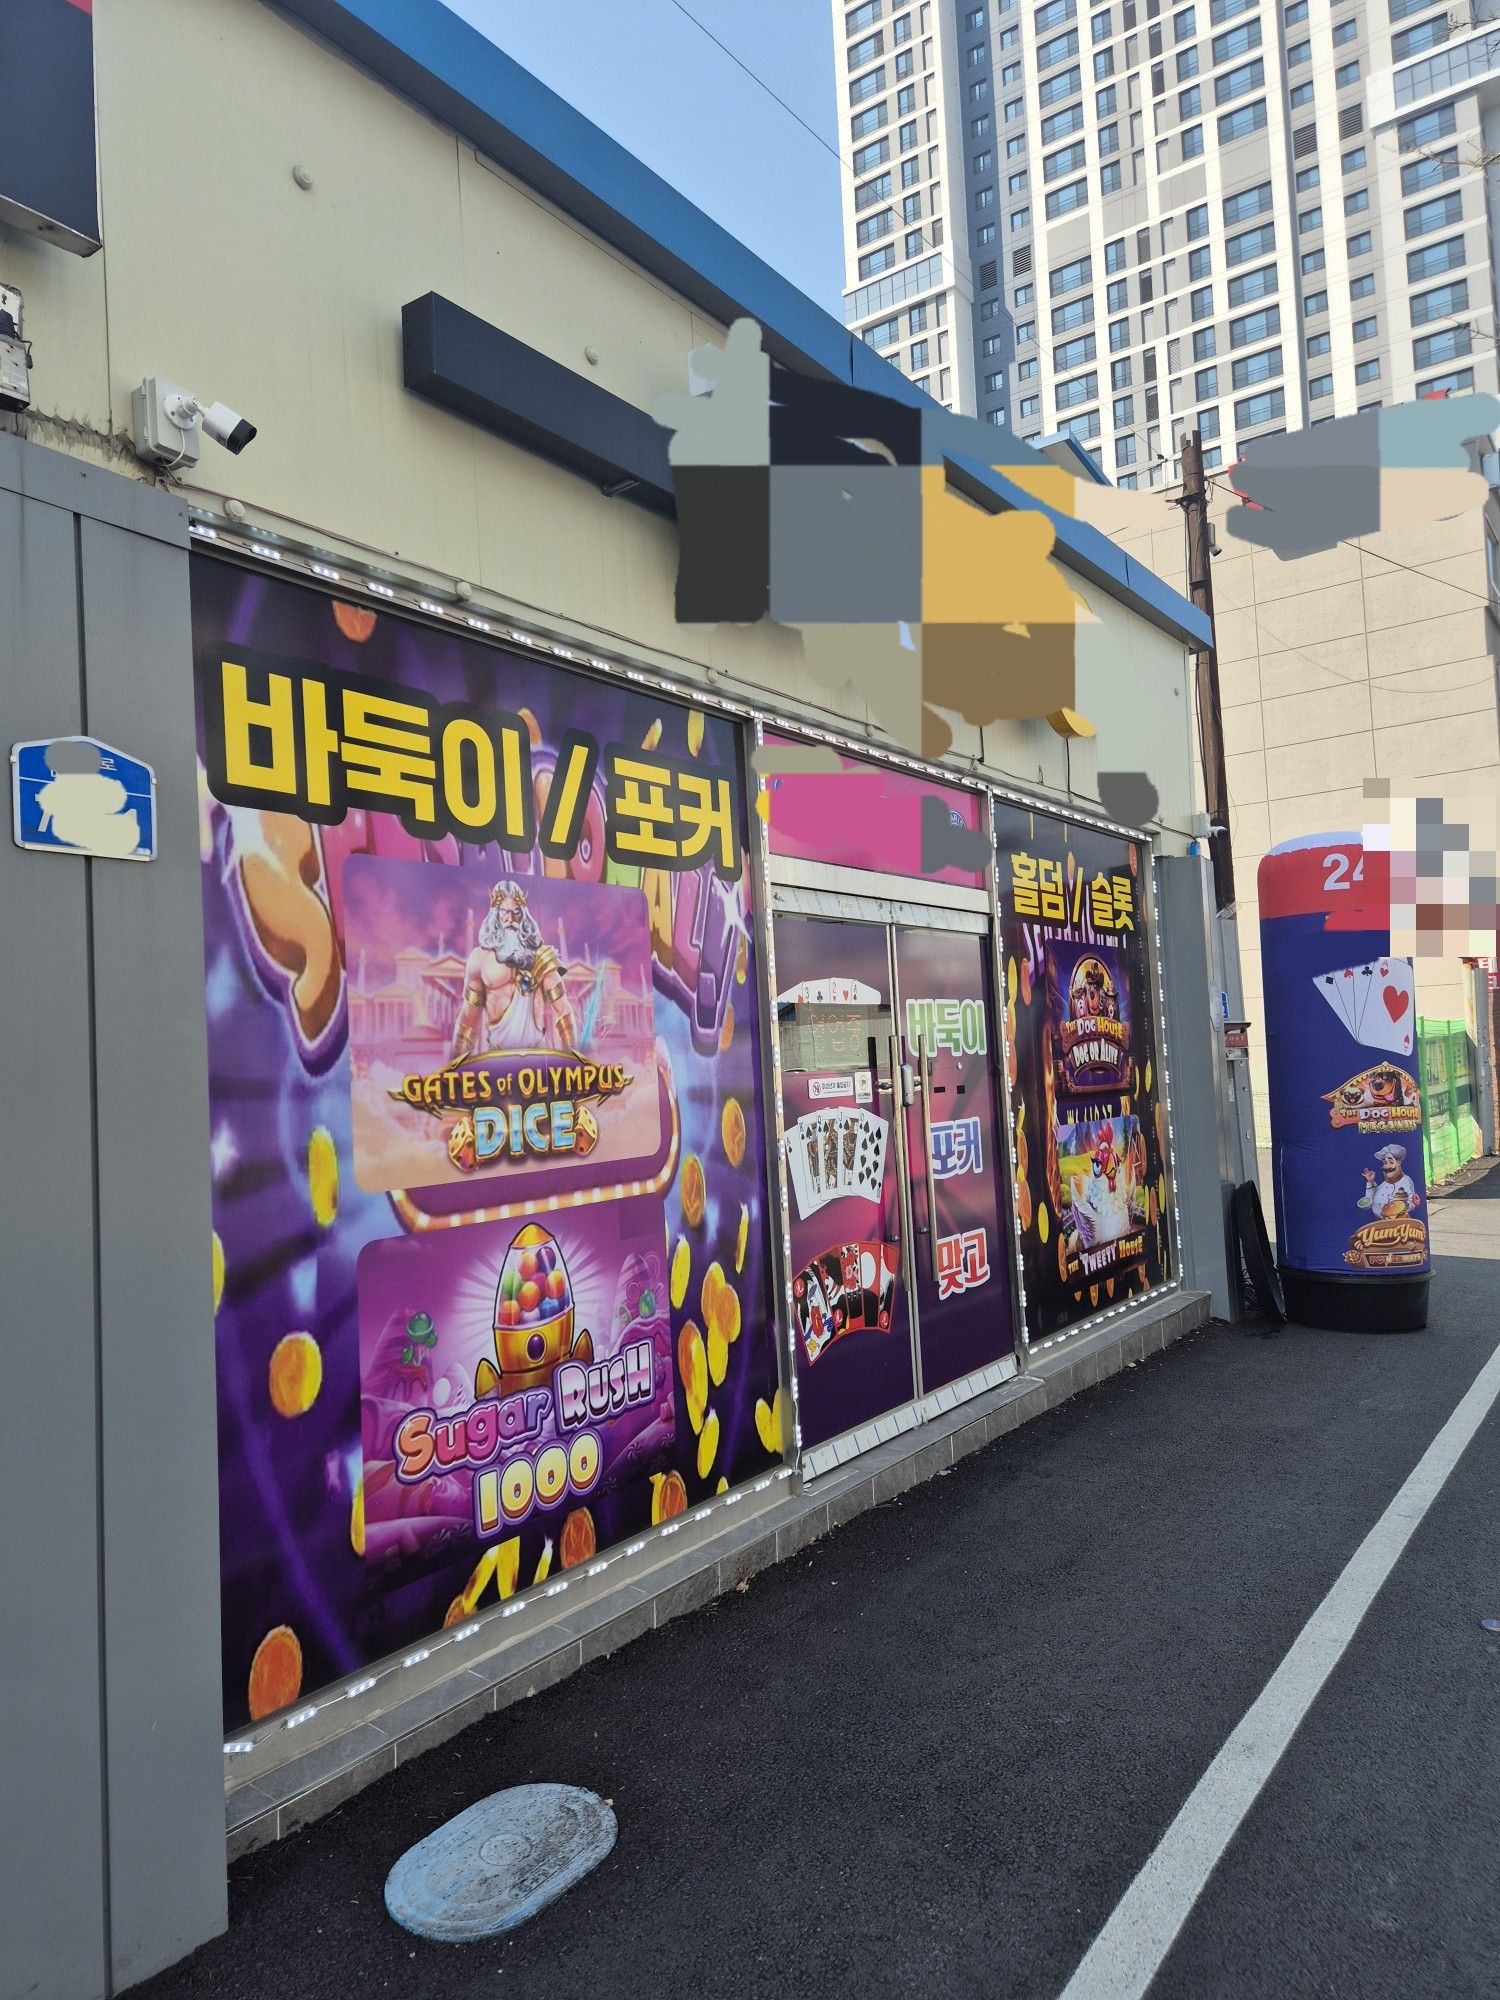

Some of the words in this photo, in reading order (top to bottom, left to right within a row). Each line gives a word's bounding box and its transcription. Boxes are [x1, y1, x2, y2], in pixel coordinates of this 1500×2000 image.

[220, 660, 526, 838] 바둑이
[614, 755, 735, 869] 포커
[1011, 851, 1065, 920] 홀덤
[1091, 871, 1134, 932] 슬롯
[907, 1000, 986, 1056] 바둑이
[1073, 1043, 1089, 1067] DOG
[1090, 1041, 1100, 1061] OR
[1101, 1038, 1119, 1064] ALIVE
[1077, 1018, 1096, 1036] DOG
[1097, 1016, 1123, 1040] HOUSE
[402, 1070, 492, 1104] GATES
[496, 1072, 513, 1093] of
[517, 1064, 626, 1097] OLYMPUS
[1360, 1108, 1389, 1119] DOG
[472, 1100, 578, 1161] DICE
[931, 1117, 983, 1179] 포커
[937, 1229, 989, 1300] 맞고
[397, 1390, 551, 1479] Sugar
[477, 1432, 600, 1532] 1000
